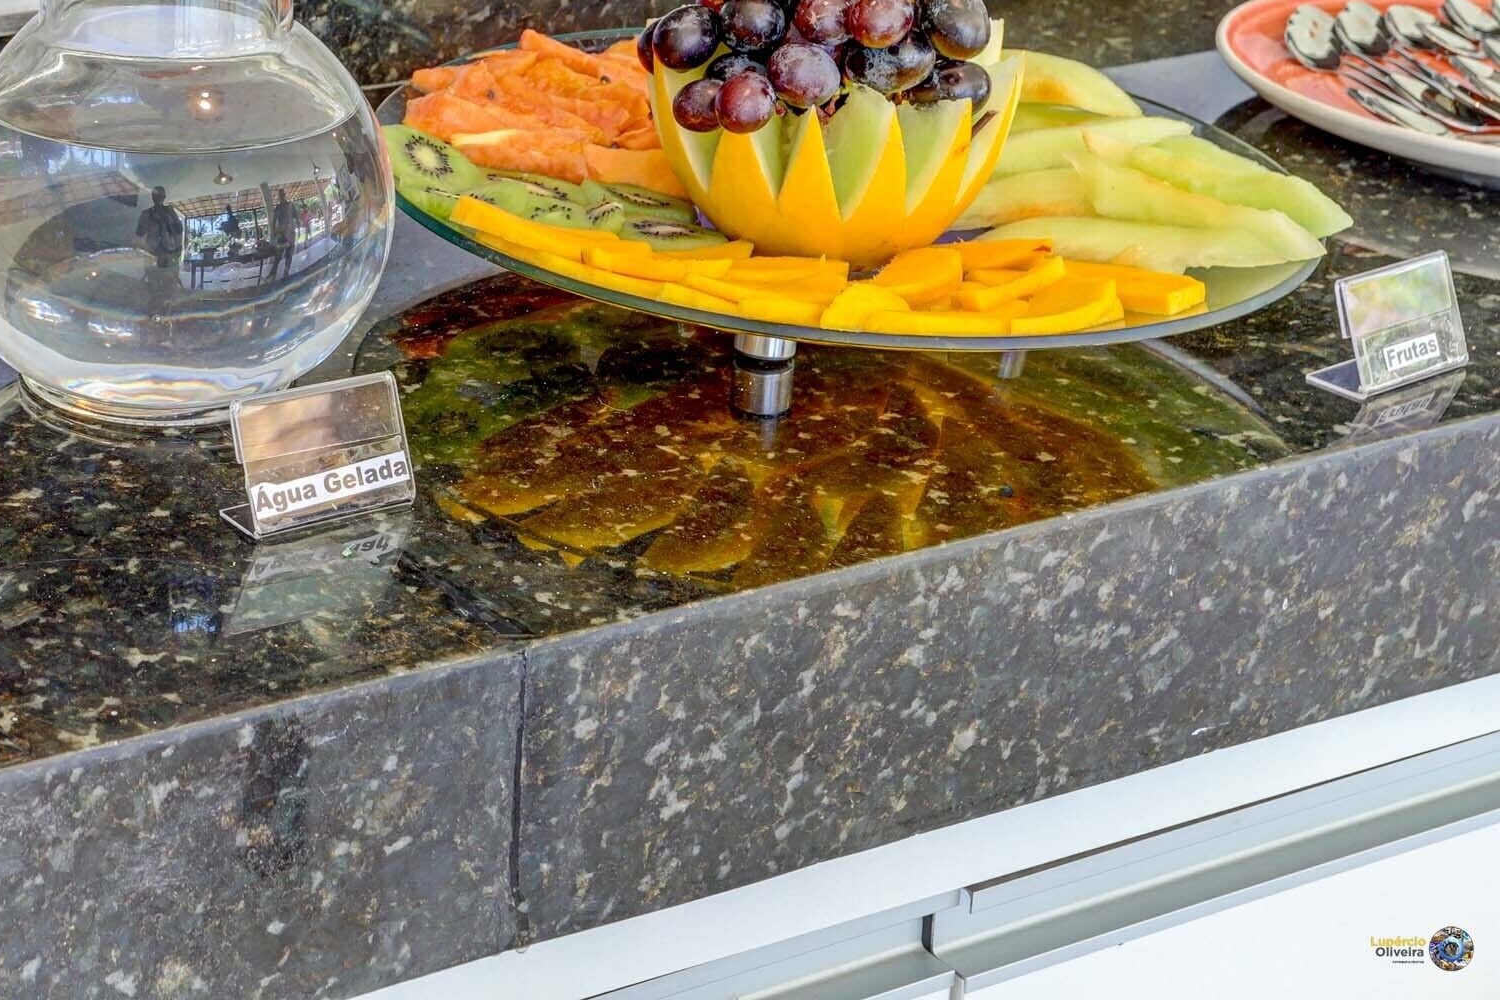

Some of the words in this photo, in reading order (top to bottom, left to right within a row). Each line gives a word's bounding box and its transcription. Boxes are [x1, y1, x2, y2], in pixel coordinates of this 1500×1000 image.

[1386, 338, 1437, 368] Frutas
[256, 483, 317, 513] Água
[323, 459, 408, 494] Gelada
